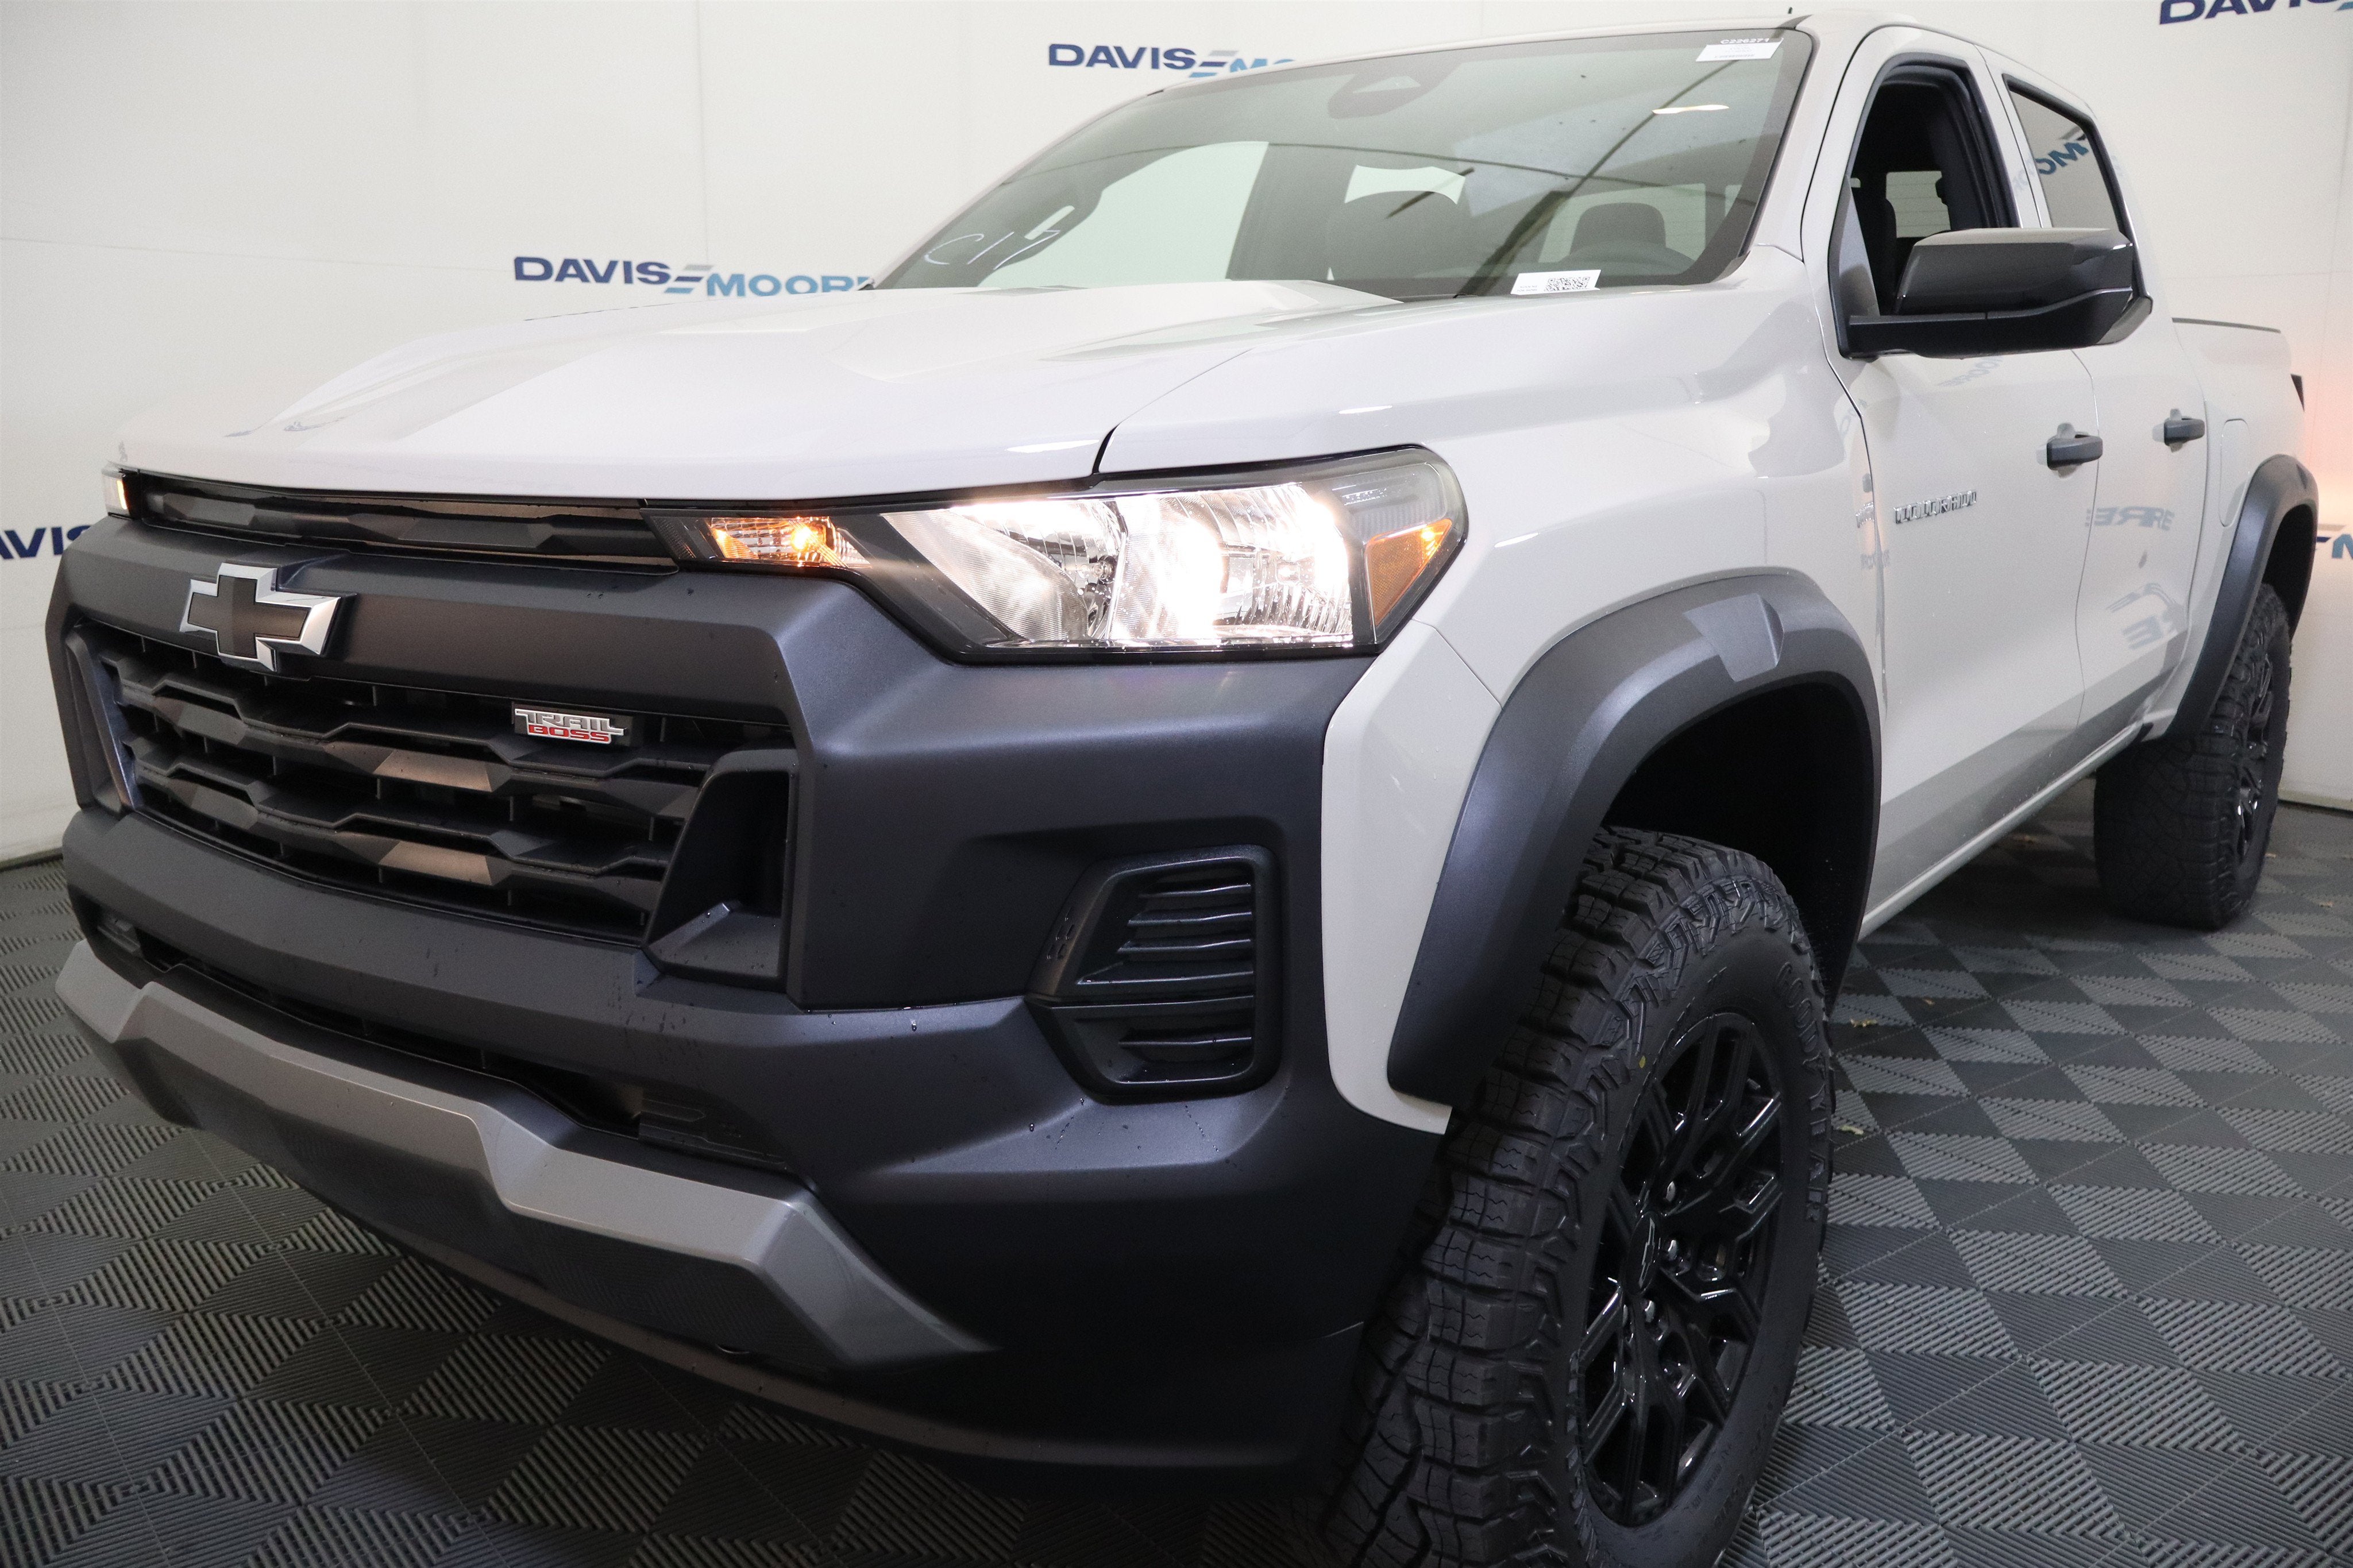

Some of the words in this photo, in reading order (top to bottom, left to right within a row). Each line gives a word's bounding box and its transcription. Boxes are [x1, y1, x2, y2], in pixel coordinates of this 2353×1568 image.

[1049, 44, 1197, 69] DAVIS
[514, 257, 672, 285] DAVIS
[707, 273, 870, 297] MOOR
[1894, 491, 1977, 524] COLORADO
[515, 708, 624, 736] TRAIL
[528, 724, 611, 744] BOSS
